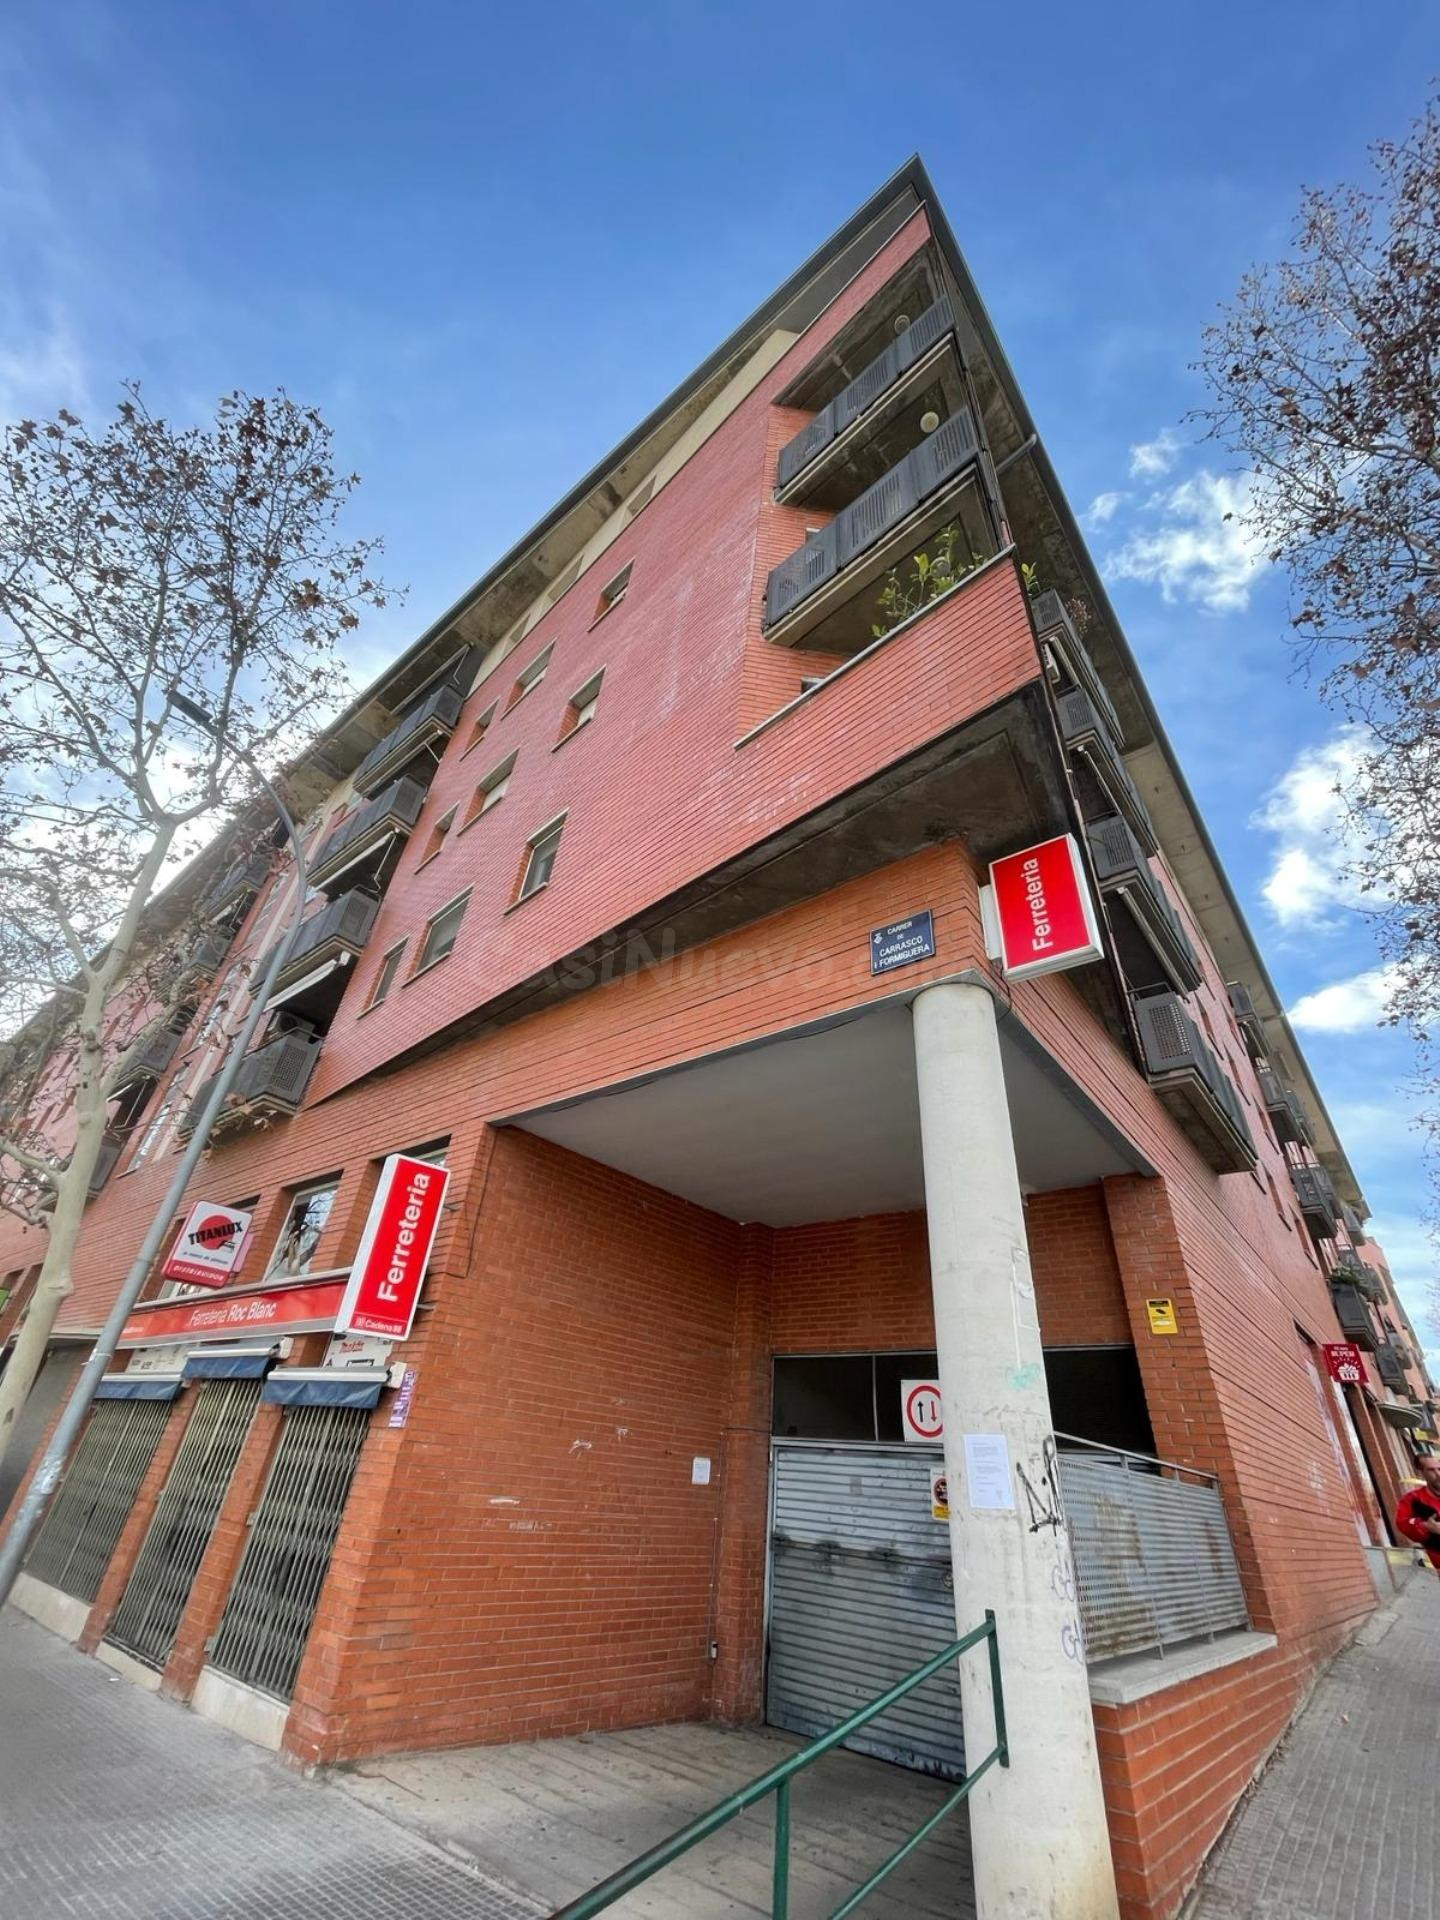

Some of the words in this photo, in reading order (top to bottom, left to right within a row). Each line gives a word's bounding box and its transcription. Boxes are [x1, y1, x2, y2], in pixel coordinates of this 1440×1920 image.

[1022, 857, 1054, 952] Ferreteria
[887, 921, 913, 935] CARRER
[879, 935, 923, 957] CARRASCO
[879, 943, 930, 967] FORMIGUERA
[188, 1221, 243, 1245] TITANLUX
[377, 1173, 431, 1302] Ferreteria
[228, 1304, 247, 1322] Roc
[248, 1301, 277, 1321] Blanc
